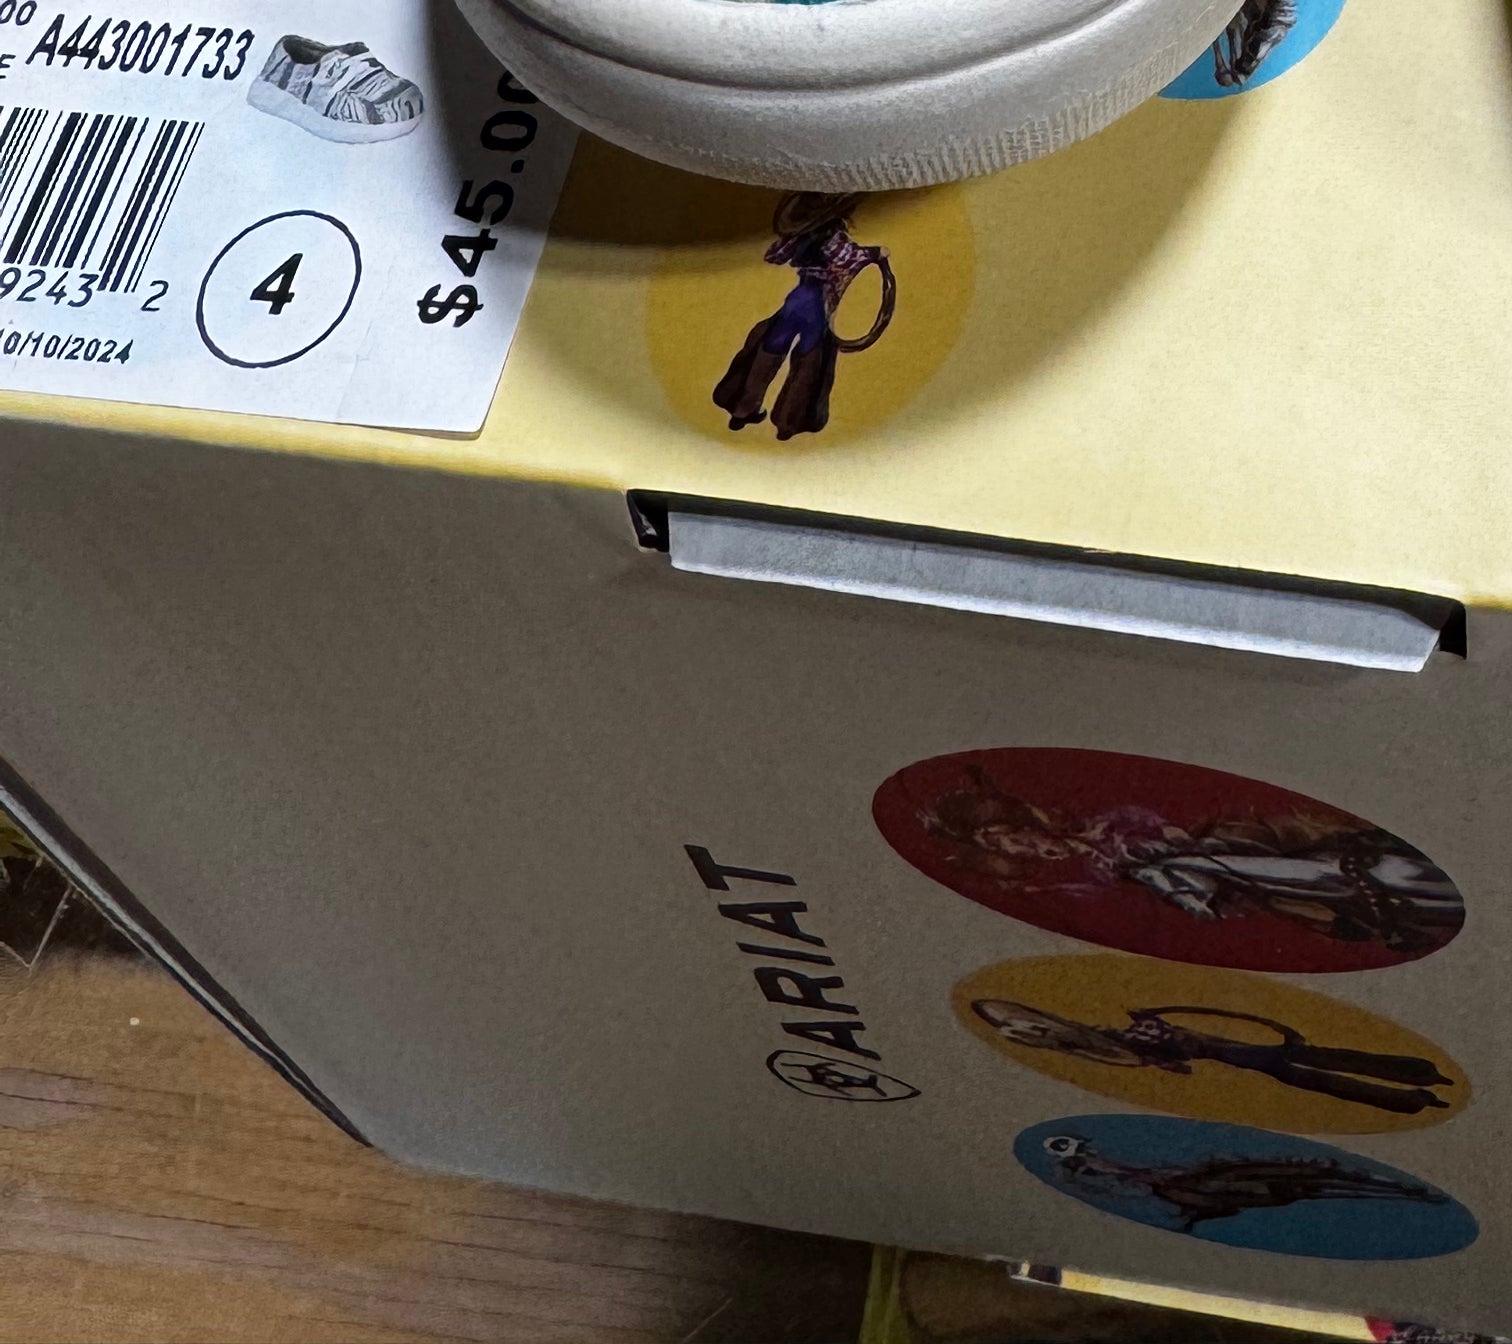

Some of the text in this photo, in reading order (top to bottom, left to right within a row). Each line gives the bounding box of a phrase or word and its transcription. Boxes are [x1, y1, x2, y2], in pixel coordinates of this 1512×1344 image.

[26, 14, 256, 81] A443001733
[416, 69, 539, 328] $45.00
[141, 280, 169, 312] 2
[251, 253, 304, 315] 4
[683, 843, 882, 1061] ARIAT
